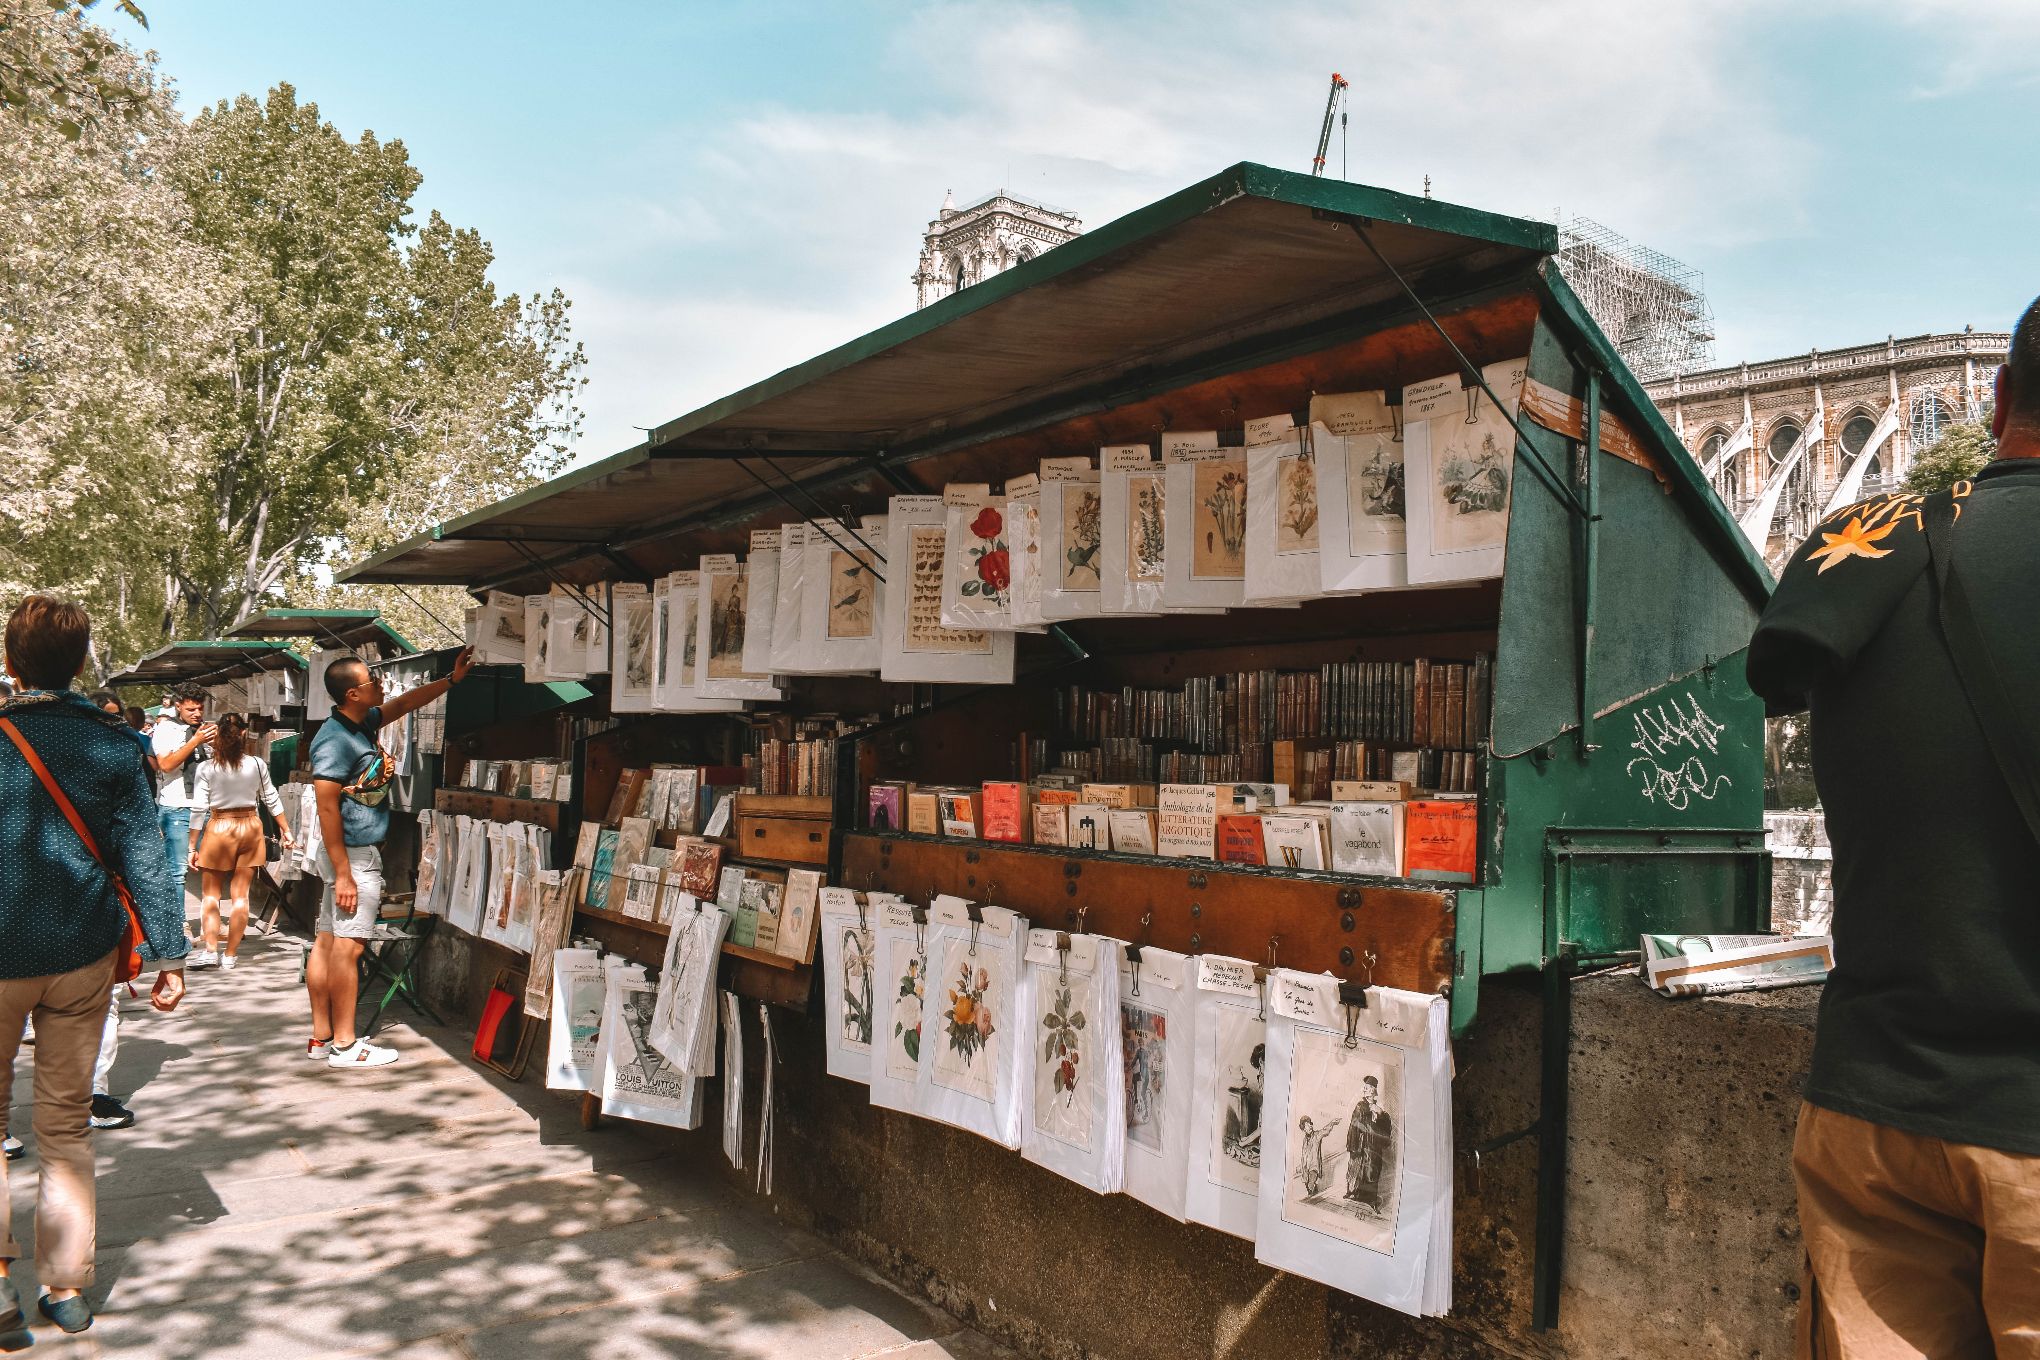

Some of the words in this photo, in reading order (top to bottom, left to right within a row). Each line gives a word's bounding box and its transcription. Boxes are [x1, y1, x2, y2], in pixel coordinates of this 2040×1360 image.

[1168, 786, 1187, 796] Jacques
[1187, 787, 1206, 796] Cellard
[1160, 800, 1195, 814] Anthologie
[1196, 802, 1205, 813] de
[1206, 802, 1214, 814] la
[1159, 825, 1215, 838] ARGOTIQUE
[1344, 839, 1382, 850] vagabond
[1279, 845, 1303, 868] W
[615, 1072, 642, 1084] LOUIS
